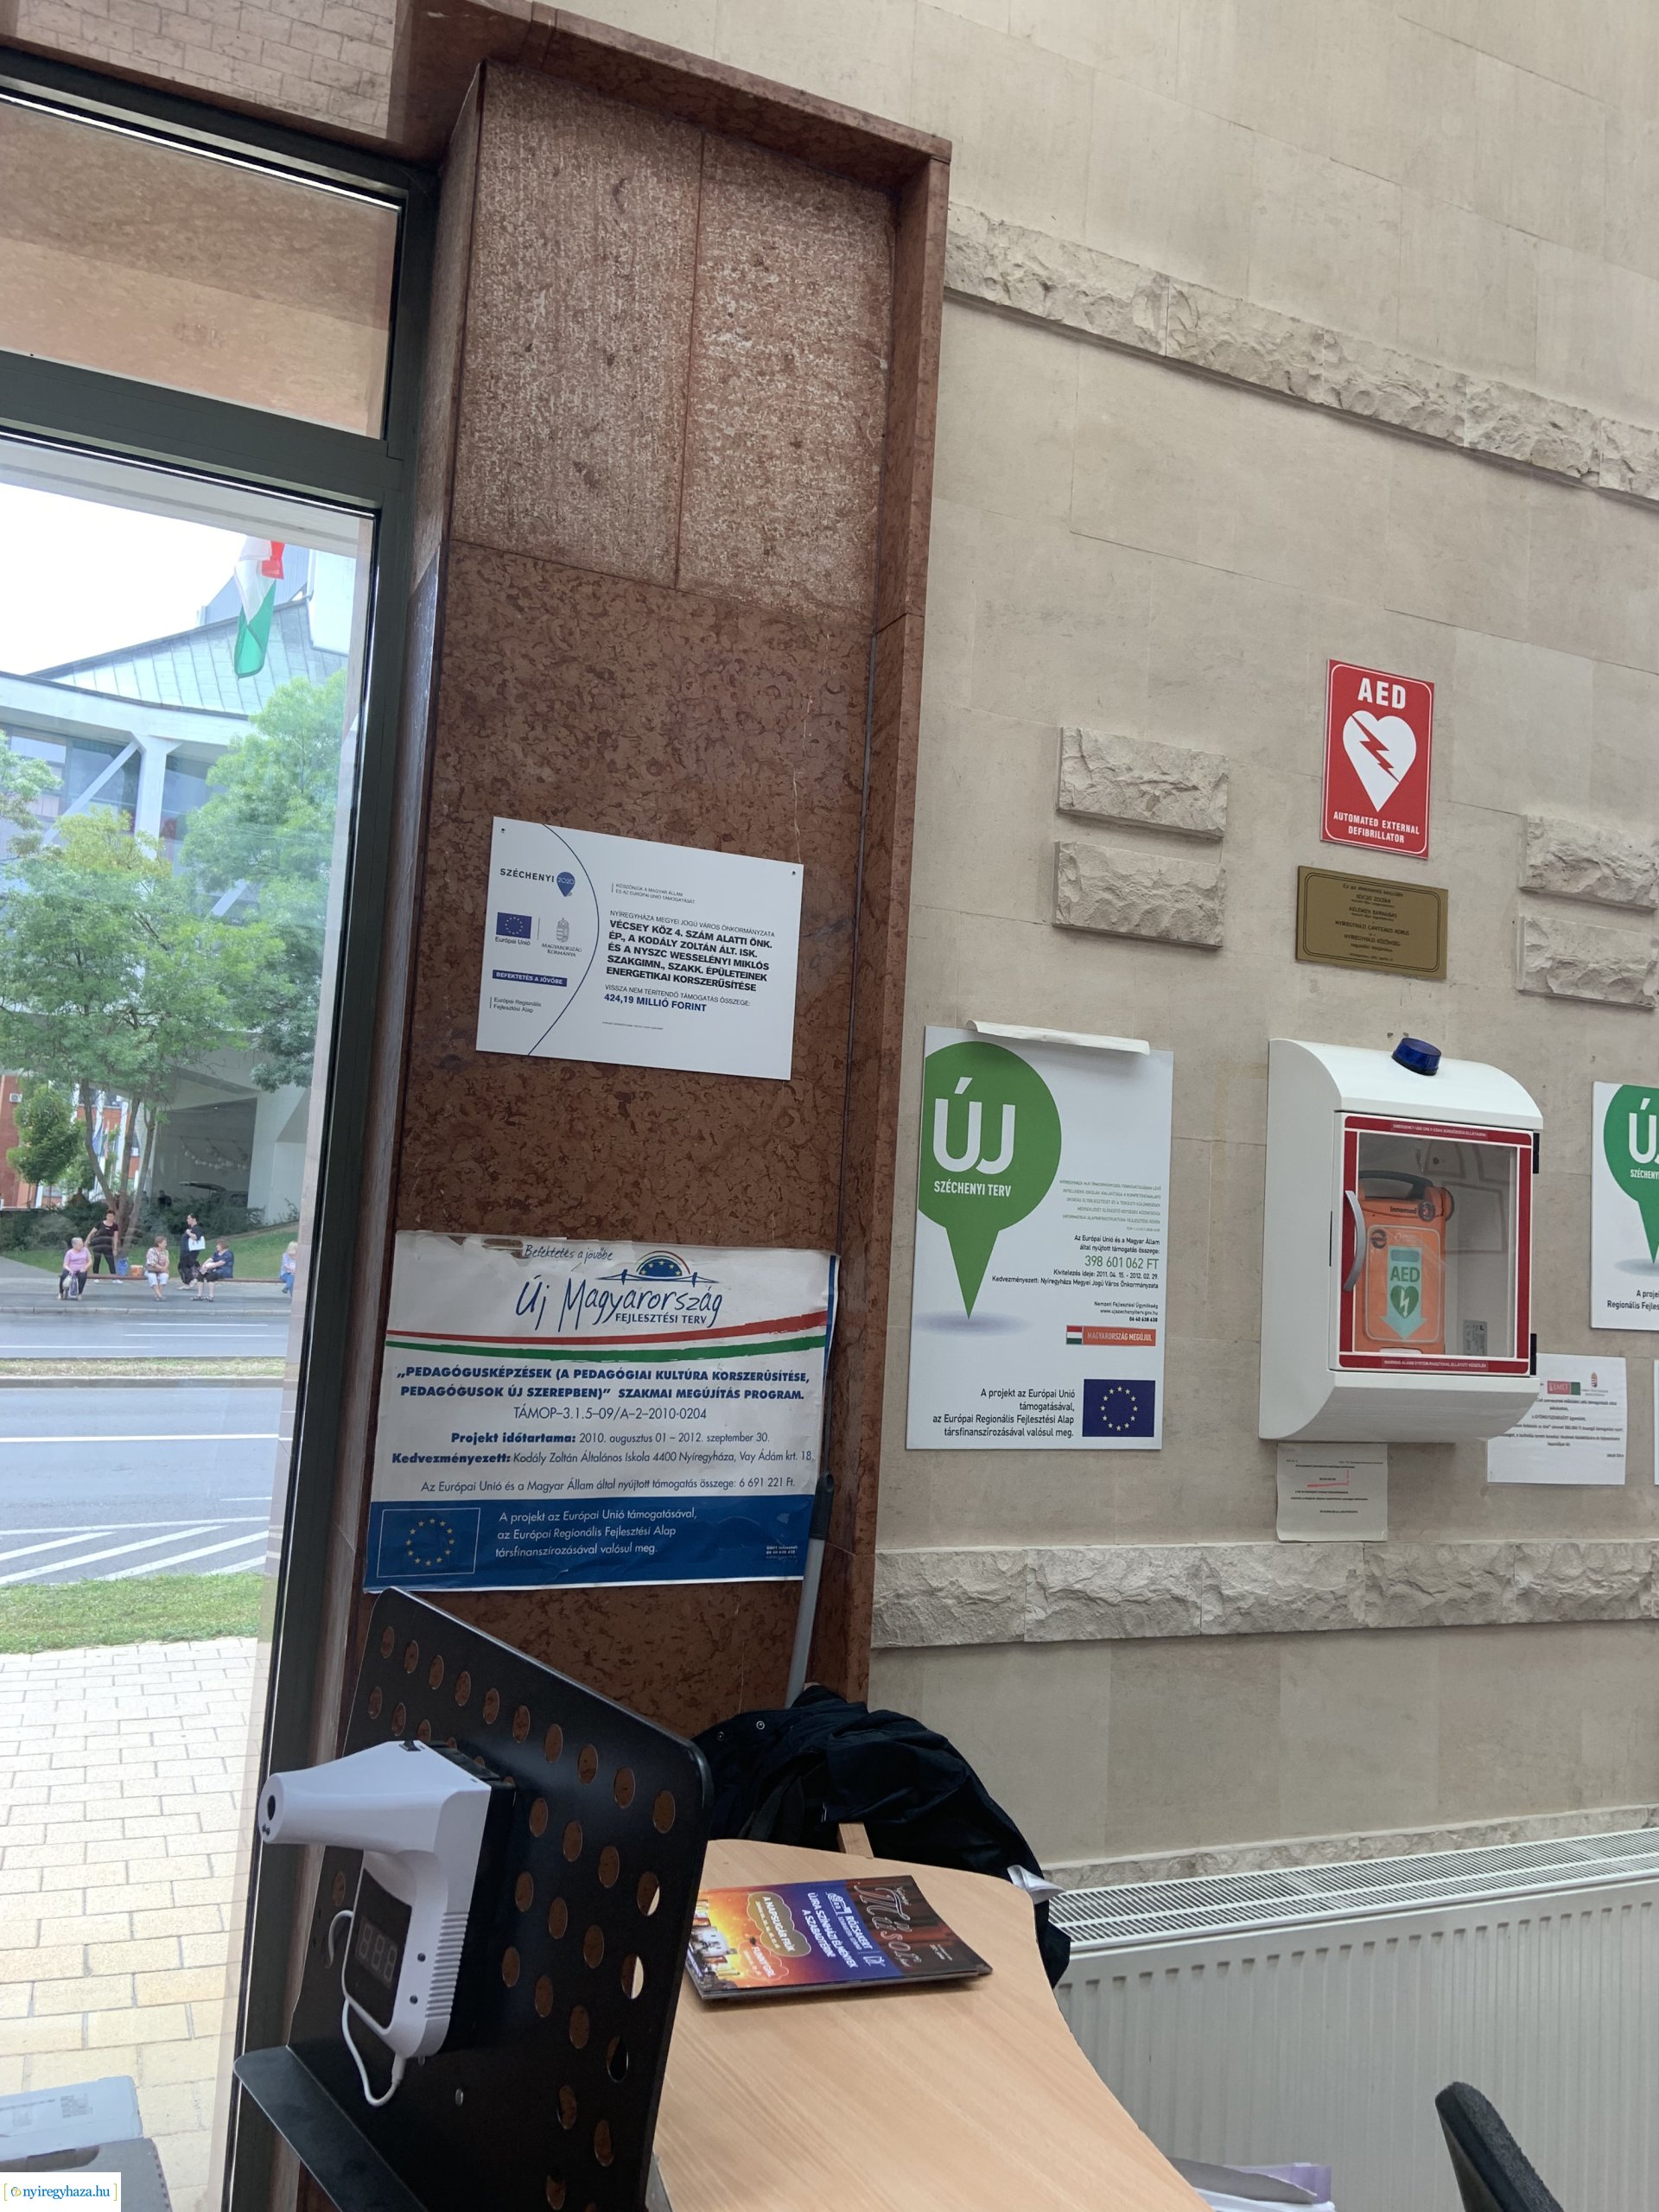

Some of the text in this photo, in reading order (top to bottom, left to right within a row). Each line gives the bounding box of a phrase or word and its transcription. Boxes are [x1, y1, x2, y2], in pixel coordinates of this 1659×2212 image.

[1357, 677, 1407, 709] AED
[1333, 810, 1420, 835] AUTOMATED EXTERNAL
[1348, 825, 1405, 843] DEFIBRILLATOR
[499, 868, 555, 883] SZÉCHENYI
[610, 910, 654, 921] NYÍREGYHÁZA
[656, 916, 679, 925] MEGYEI
[609, 918, 772, 949] VÉCSEY KÖZ 4. SZÁM ALATTI ÖNK.
[638, 935, 678, 948] KODÁLY
[680, 941, 717, 952] ZOLTÁN
[719, 944, 737, 956] ÁLT.
[739, 948, 758, 958] ISK.
[607, 941, 621, 952] ÉS
[633, 946, 667, 957] NYSZC
[670, 950, 731, 966] WESSELÉNYI
[733, 958, 770, 970] MIKLÓS
[496, 971, 533, 982] BEFEKTETÉS
[606, 966, 757, 992] ENERGETIKAI KORSZERŰSÍTÉSE
[667, 962, 704, 974] SZAKK.
[706, 965, 767, 982] ÉPÜLETEINEK
[604, 993, 707, 1012] 424,19 MILLIÓ FORINT
[680, 992, 719, 1003] TÁMOGATÁS
[932, 1077, 1016, 1175] ÚJ
[933, 1178, 1012, 1198] SZÉCHENYI TERV
[1082, 1235, 1102, 1243] Európai
[1126, 1237, 1145, 1246] Magyar
[1145, 1236, 1160, 1245] Állam
[524, 1244, 574, 1259] Befektetés
[1091, 1244, 1111, 1253] nyújtott
[1111, 1245, 1138, 1254] támogatás
[1084, 1255, 1160, 1269] 398 601 062 FT
[992, 1275, 1039, 1284] Kedvezményezett:
[1040, 1277, 1072, 1287] Nyíregyháza
[1091, 1279, 1104, 1287] Jogú
[1390, 1266, 1421, 1282] AED
[516, 1274, 723, 1332] Új Magyarország
[1642, 1290, 1659, 1300] proje
[1607, 1300, 1640, 1310] Regionális
[615, 1312, 708, 1325] FEJLESZTÉSI TERV
[1087, 1330, 1128, 1341] MAGYARORSZÁG
[556, 1368, 569, 1381] (A
[573, 1367, 652, 1380] PEDAGÓGIAI
[656, 1368, 709, 1381] KULTÚRA
[400, 1383, 805, 1400] PEDAGÓGUSOK ÚJ SZAKMAI MEGÚJÍTÁS PROGRAM.
[980, 1389, 987, 1397] A
[988, 1389, 1016, 1400] projekt
[1028, 1389, 1057, 1400] Európai
[1058, 1389, 1076, 1398] Unió
[1019, 1401, 1075, 1413] támogatásával,
[944, 1414, 974, 1425] Európai
[976, 1414, 1014, 1425] Regionális
[1016, 1414, 1056, 1426] Fejlesztési
[1057, 1414, 1075, 1426] Alap
[451, 1432, 770, 1446] Projekt időtartama: 2010. augusztus 01 2012. szeptember 30.
[944, 1427, 1074, 1439] társfinanszírozásával valósul meg.
[391, 1448, 798, 1465] Kedvezményezett: Kodály Zoltán Általános Iskola 4400 Nyíregyháza, Vay Ádám krt.
[421, 1477, 784, 1494] Az Európai Unió és Magyar Állam által nyújtott támogatás összege: 6 691 221
[499, 1511, 508, 1522] A
[510, 1510, 546, 1525] projekt
[563, 1510, 600, 1523] Európai
[601, 1510, 626, 1520] Unió
[626, 1507, 698, 1522] támogatásával,
[497, 1524, 677, 1541] az Európai Regionális Fejlesztési Alap
[495, 1541, 658, 1558] társfinanszírozásával valósul meg.
[764, 1901, 787, 1938] NAPSUGÁR
